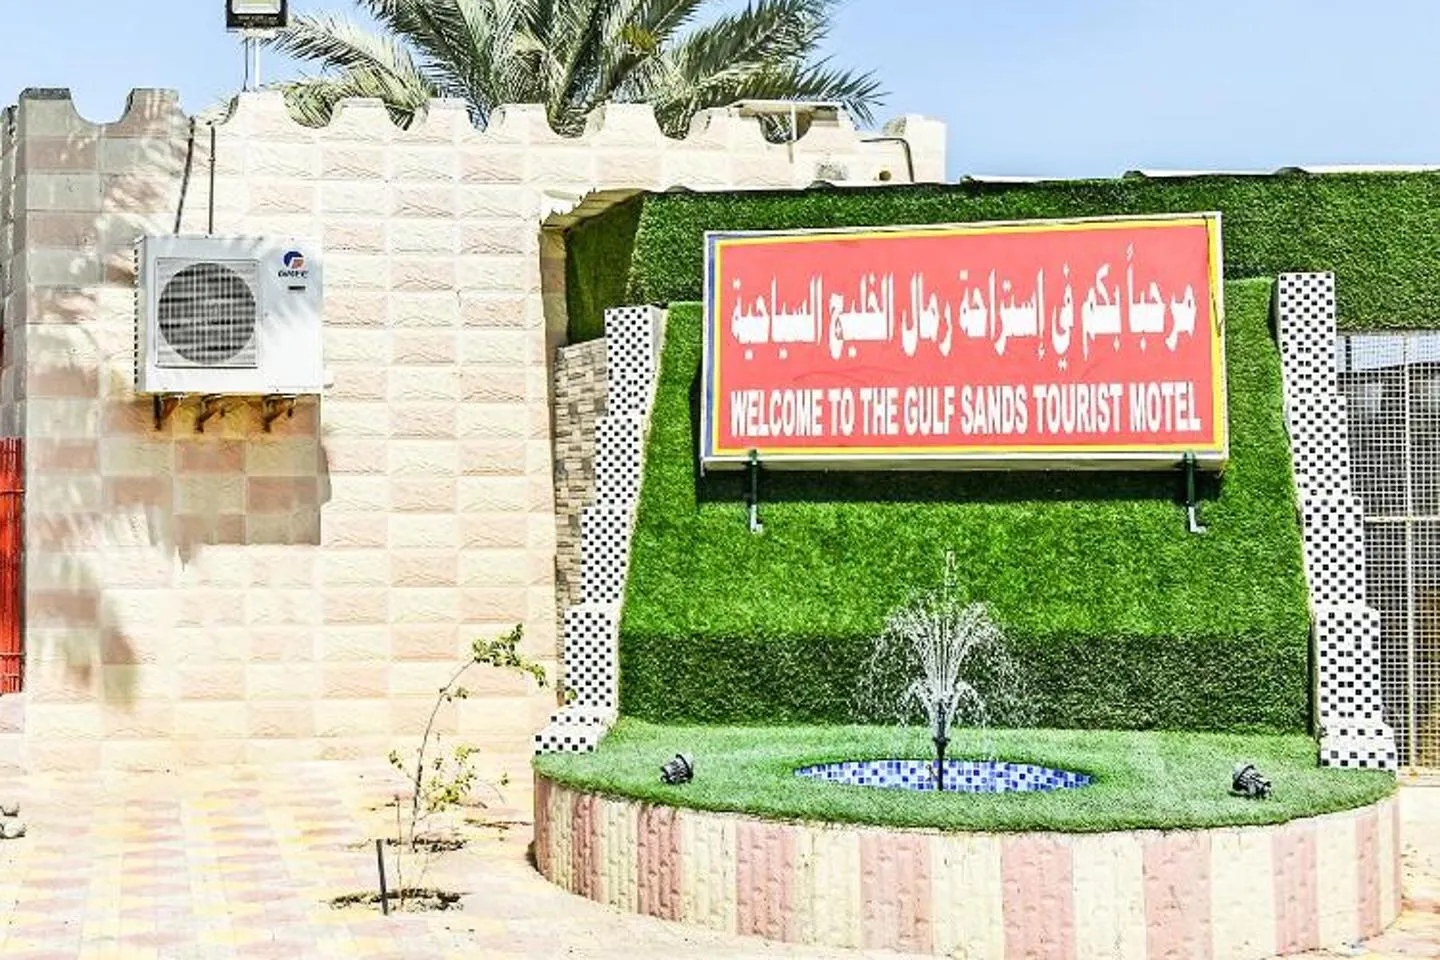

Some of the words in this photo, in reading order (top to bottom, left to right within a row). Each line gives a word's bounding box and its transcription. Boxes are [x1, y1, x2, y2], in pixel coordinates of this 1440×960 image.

[730, 272, 824, 361] السياحية
[828, 271, 895, 361] الخليج
[901, 271, 953, 358] رمال
[1051, 261, 1075, 372] في
[1081, 263, 1122, 362] بكم
[730, 389, 824, 437] WELCOME
[827, 388, 856, 436] TO
[859, 387, 900, 436] THE
[903, 385, 955, 435] GULF
[960, 384, 1028, 434] SANDS
[1032, 382, 1123, 433] TOURIST
[1128, 381, 1202, 433] MOTEL
